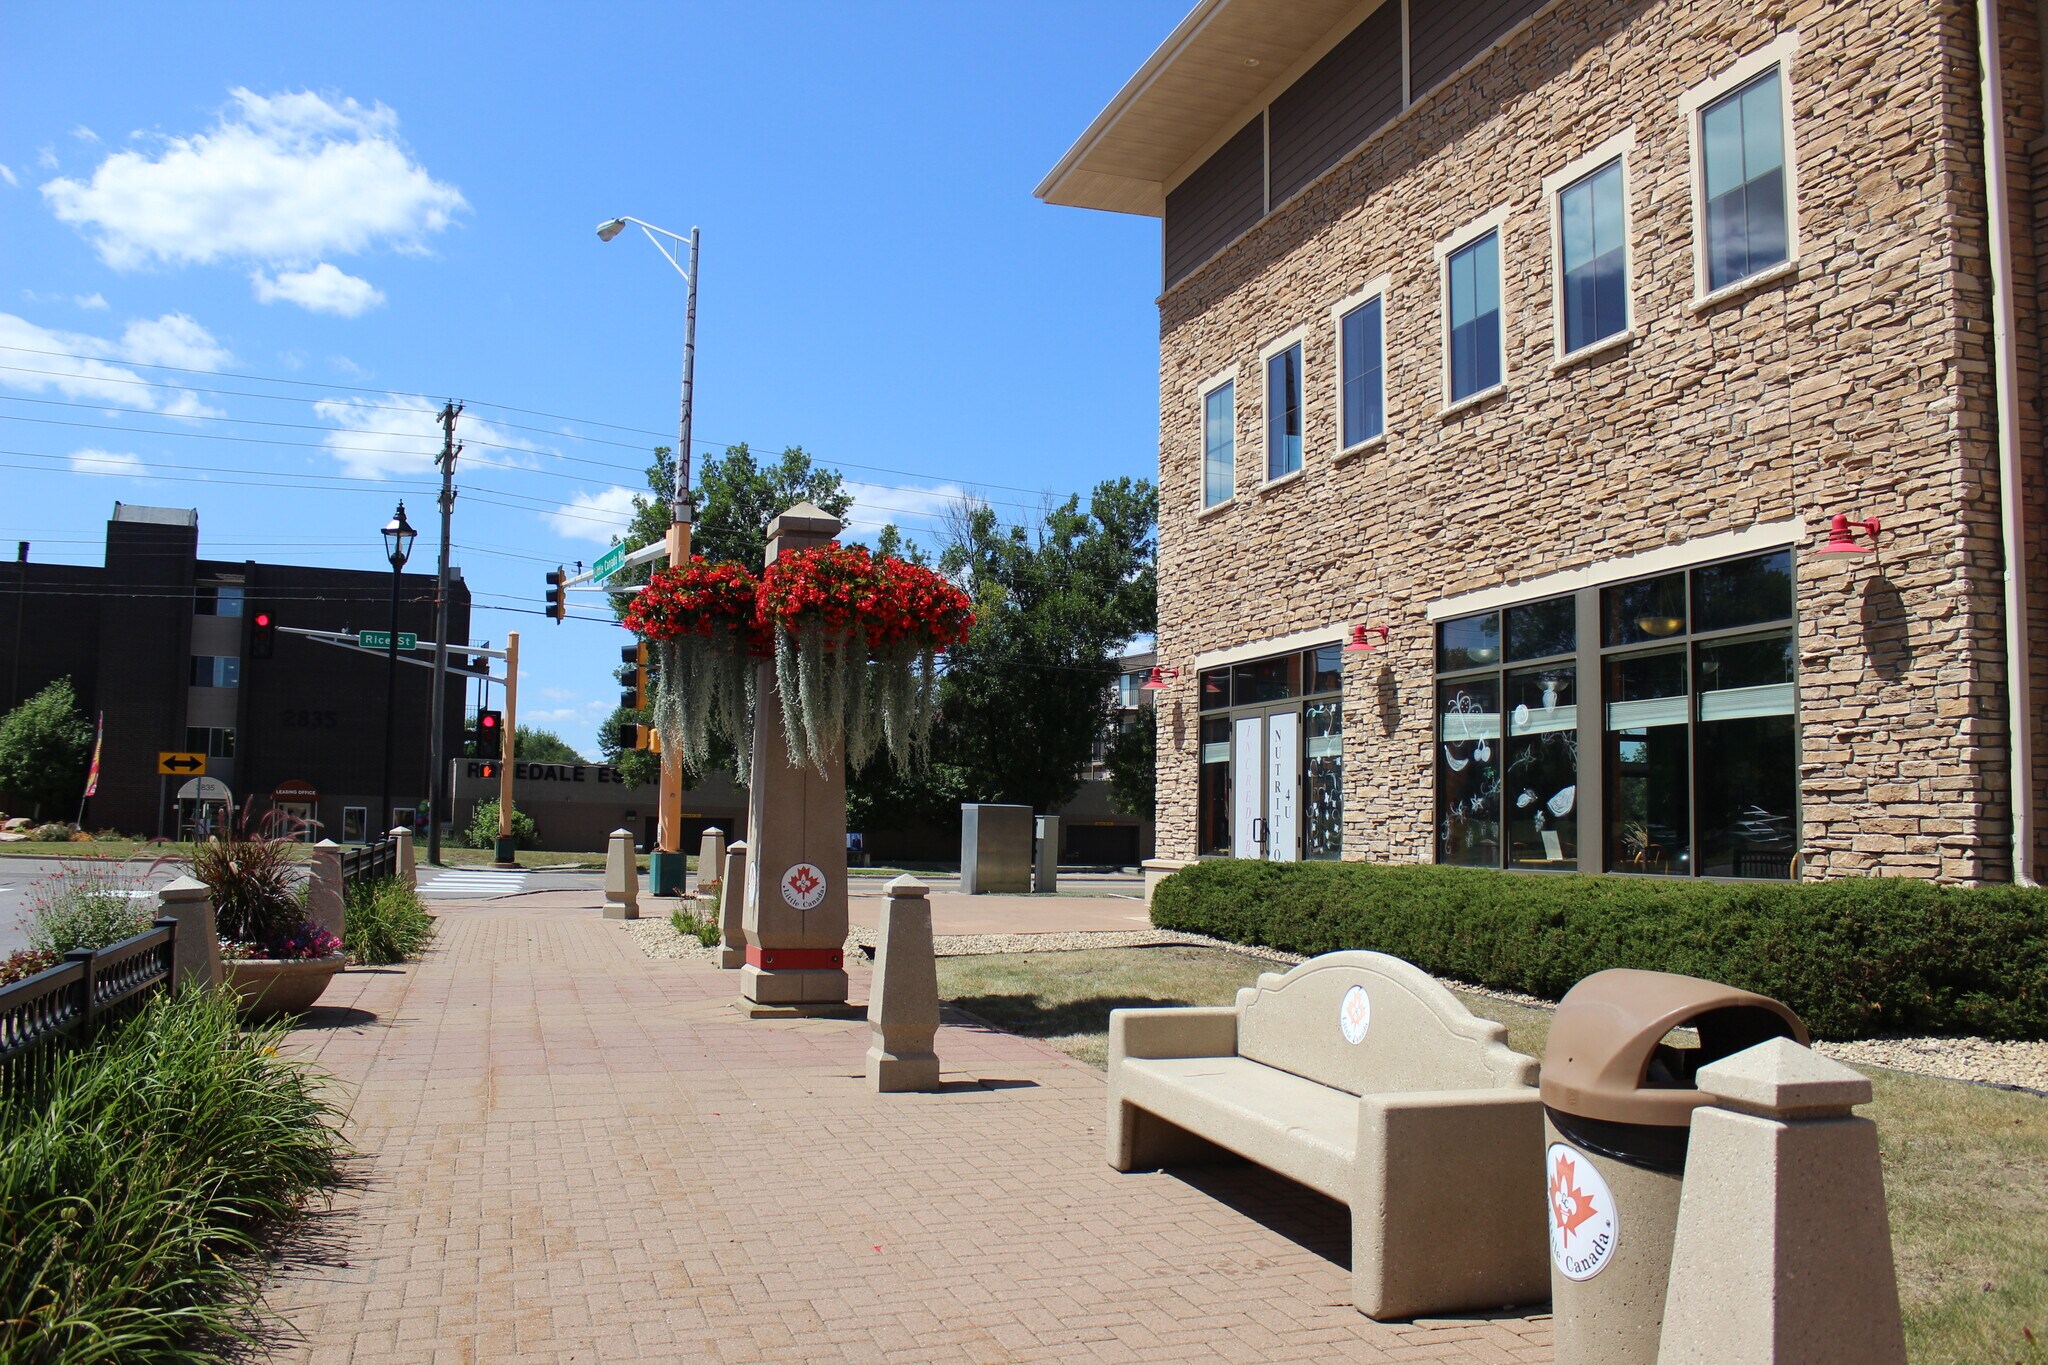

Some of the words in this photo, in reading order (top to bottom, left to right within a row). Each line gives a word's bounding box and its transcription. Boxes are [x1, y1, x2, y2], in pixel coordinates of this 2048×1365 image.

[365, 635, 391, 645] Rice
[397, 637, 410, 646] St
[467, 763, 585, 782] REDALE
[1274, 729, 1282, 861] NUTRITIO
[1285, 789, 1291, 801] 4
[1284, 806, 1291, 819] U
[783, 889, 800, 907] Little
[803, 889, 825, 908] Canada
[1565, 1233, 1610, 1274] Canada
